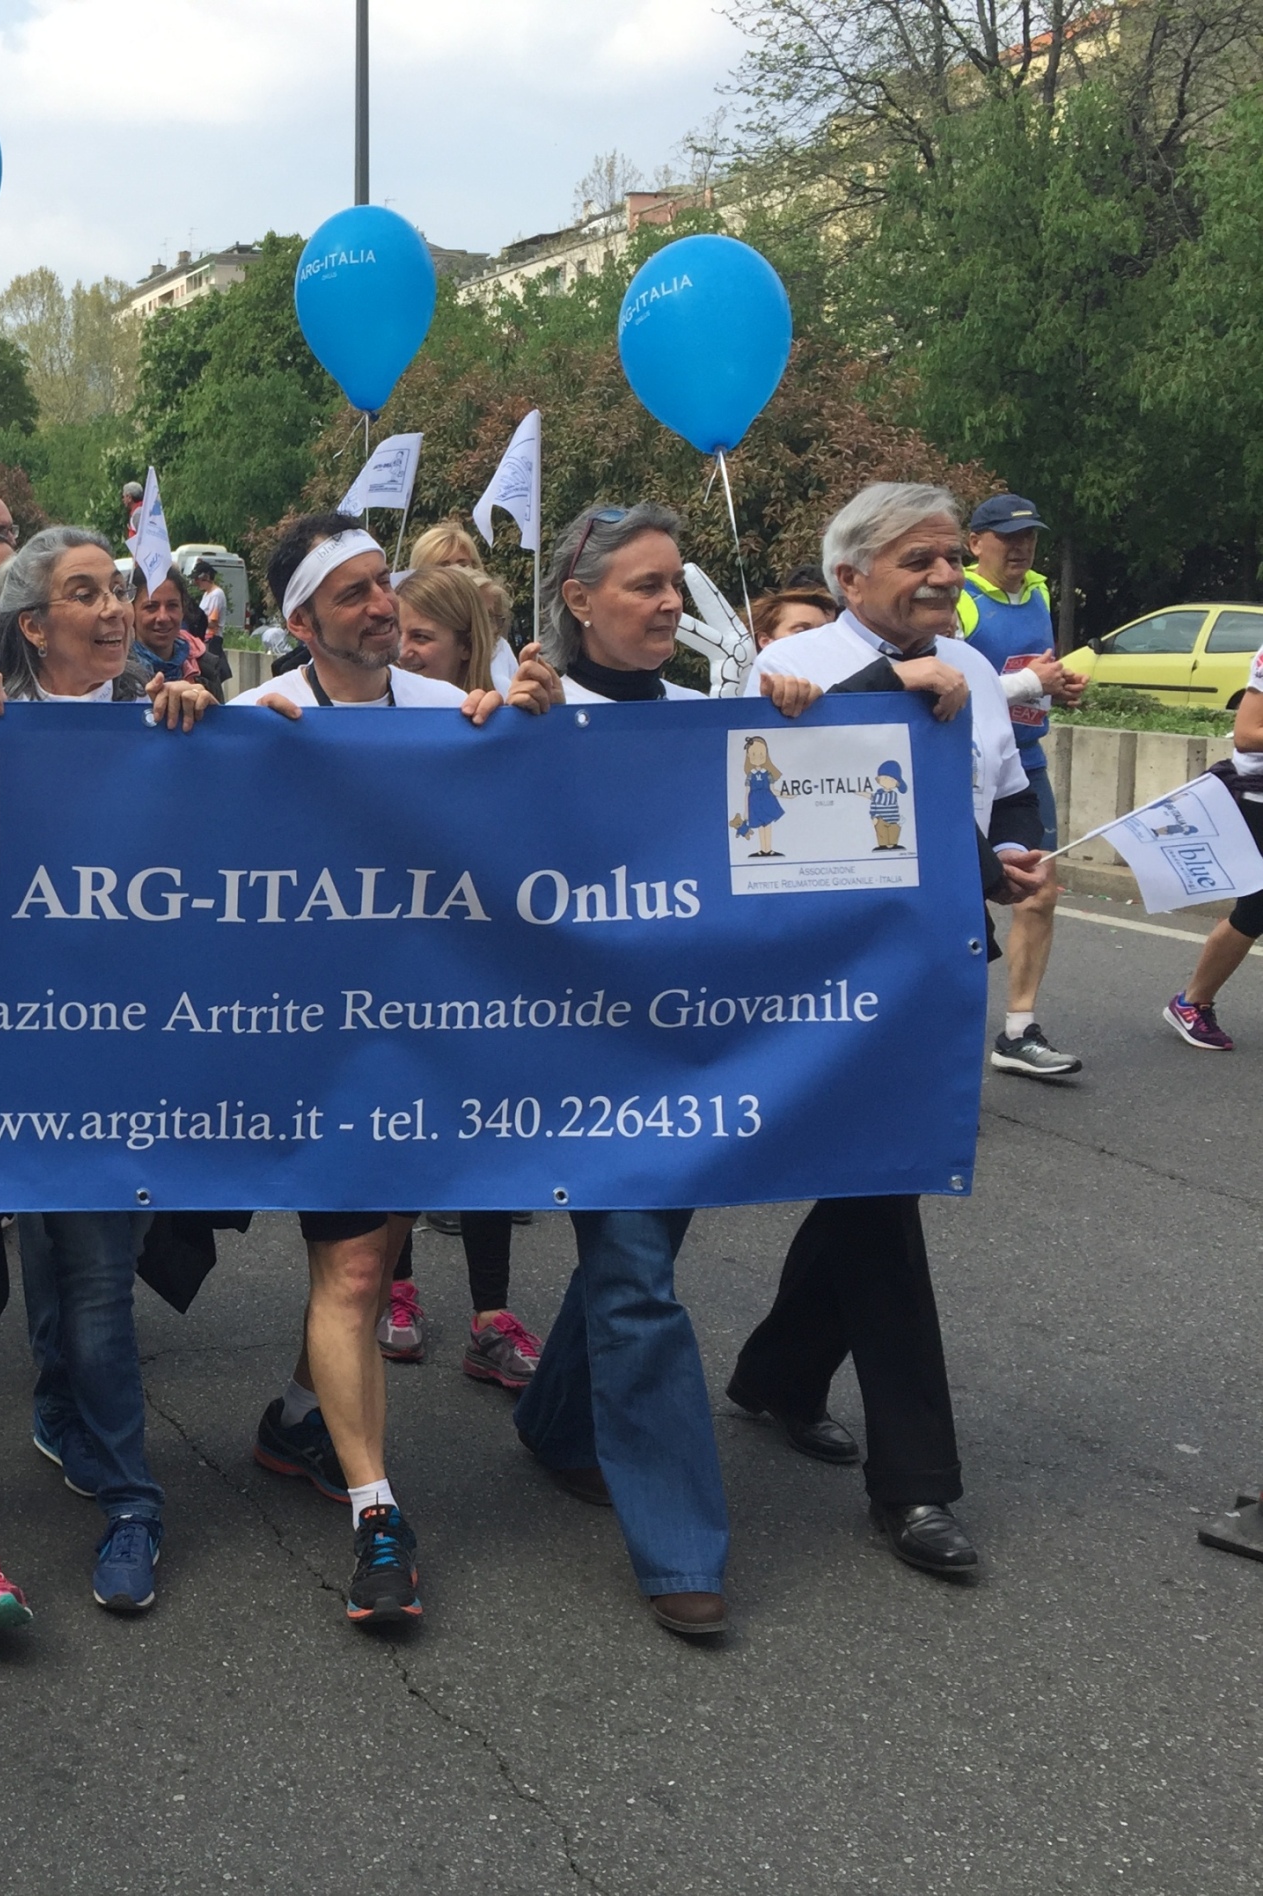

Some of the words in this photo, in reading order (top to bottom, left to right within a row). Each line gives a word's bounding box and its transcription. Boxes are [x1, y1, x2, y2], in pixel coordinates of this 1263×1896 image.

[300, 249, 377, 284] ARG-ITALIA
[619, 274, 694, 336] RG-ITALIA
[1011, 706, 1039, 721] EA7
[780, 776, 874, 796] ARG-ITALIA
[1177, 846, 1216, 889] blue
[11, 864, 492, 923] ARG-ITALIA
[516, 864, 702, 925] Onlus
[161, 991, 325, 1035] Artrite
[339, 988, 633, 1031] Reumatoide
[647, 978, 879, 1029] Giovanile
[370, 1098, 439, 1141] tel.
[457, 1094, 763, 1140] 340.2264313
